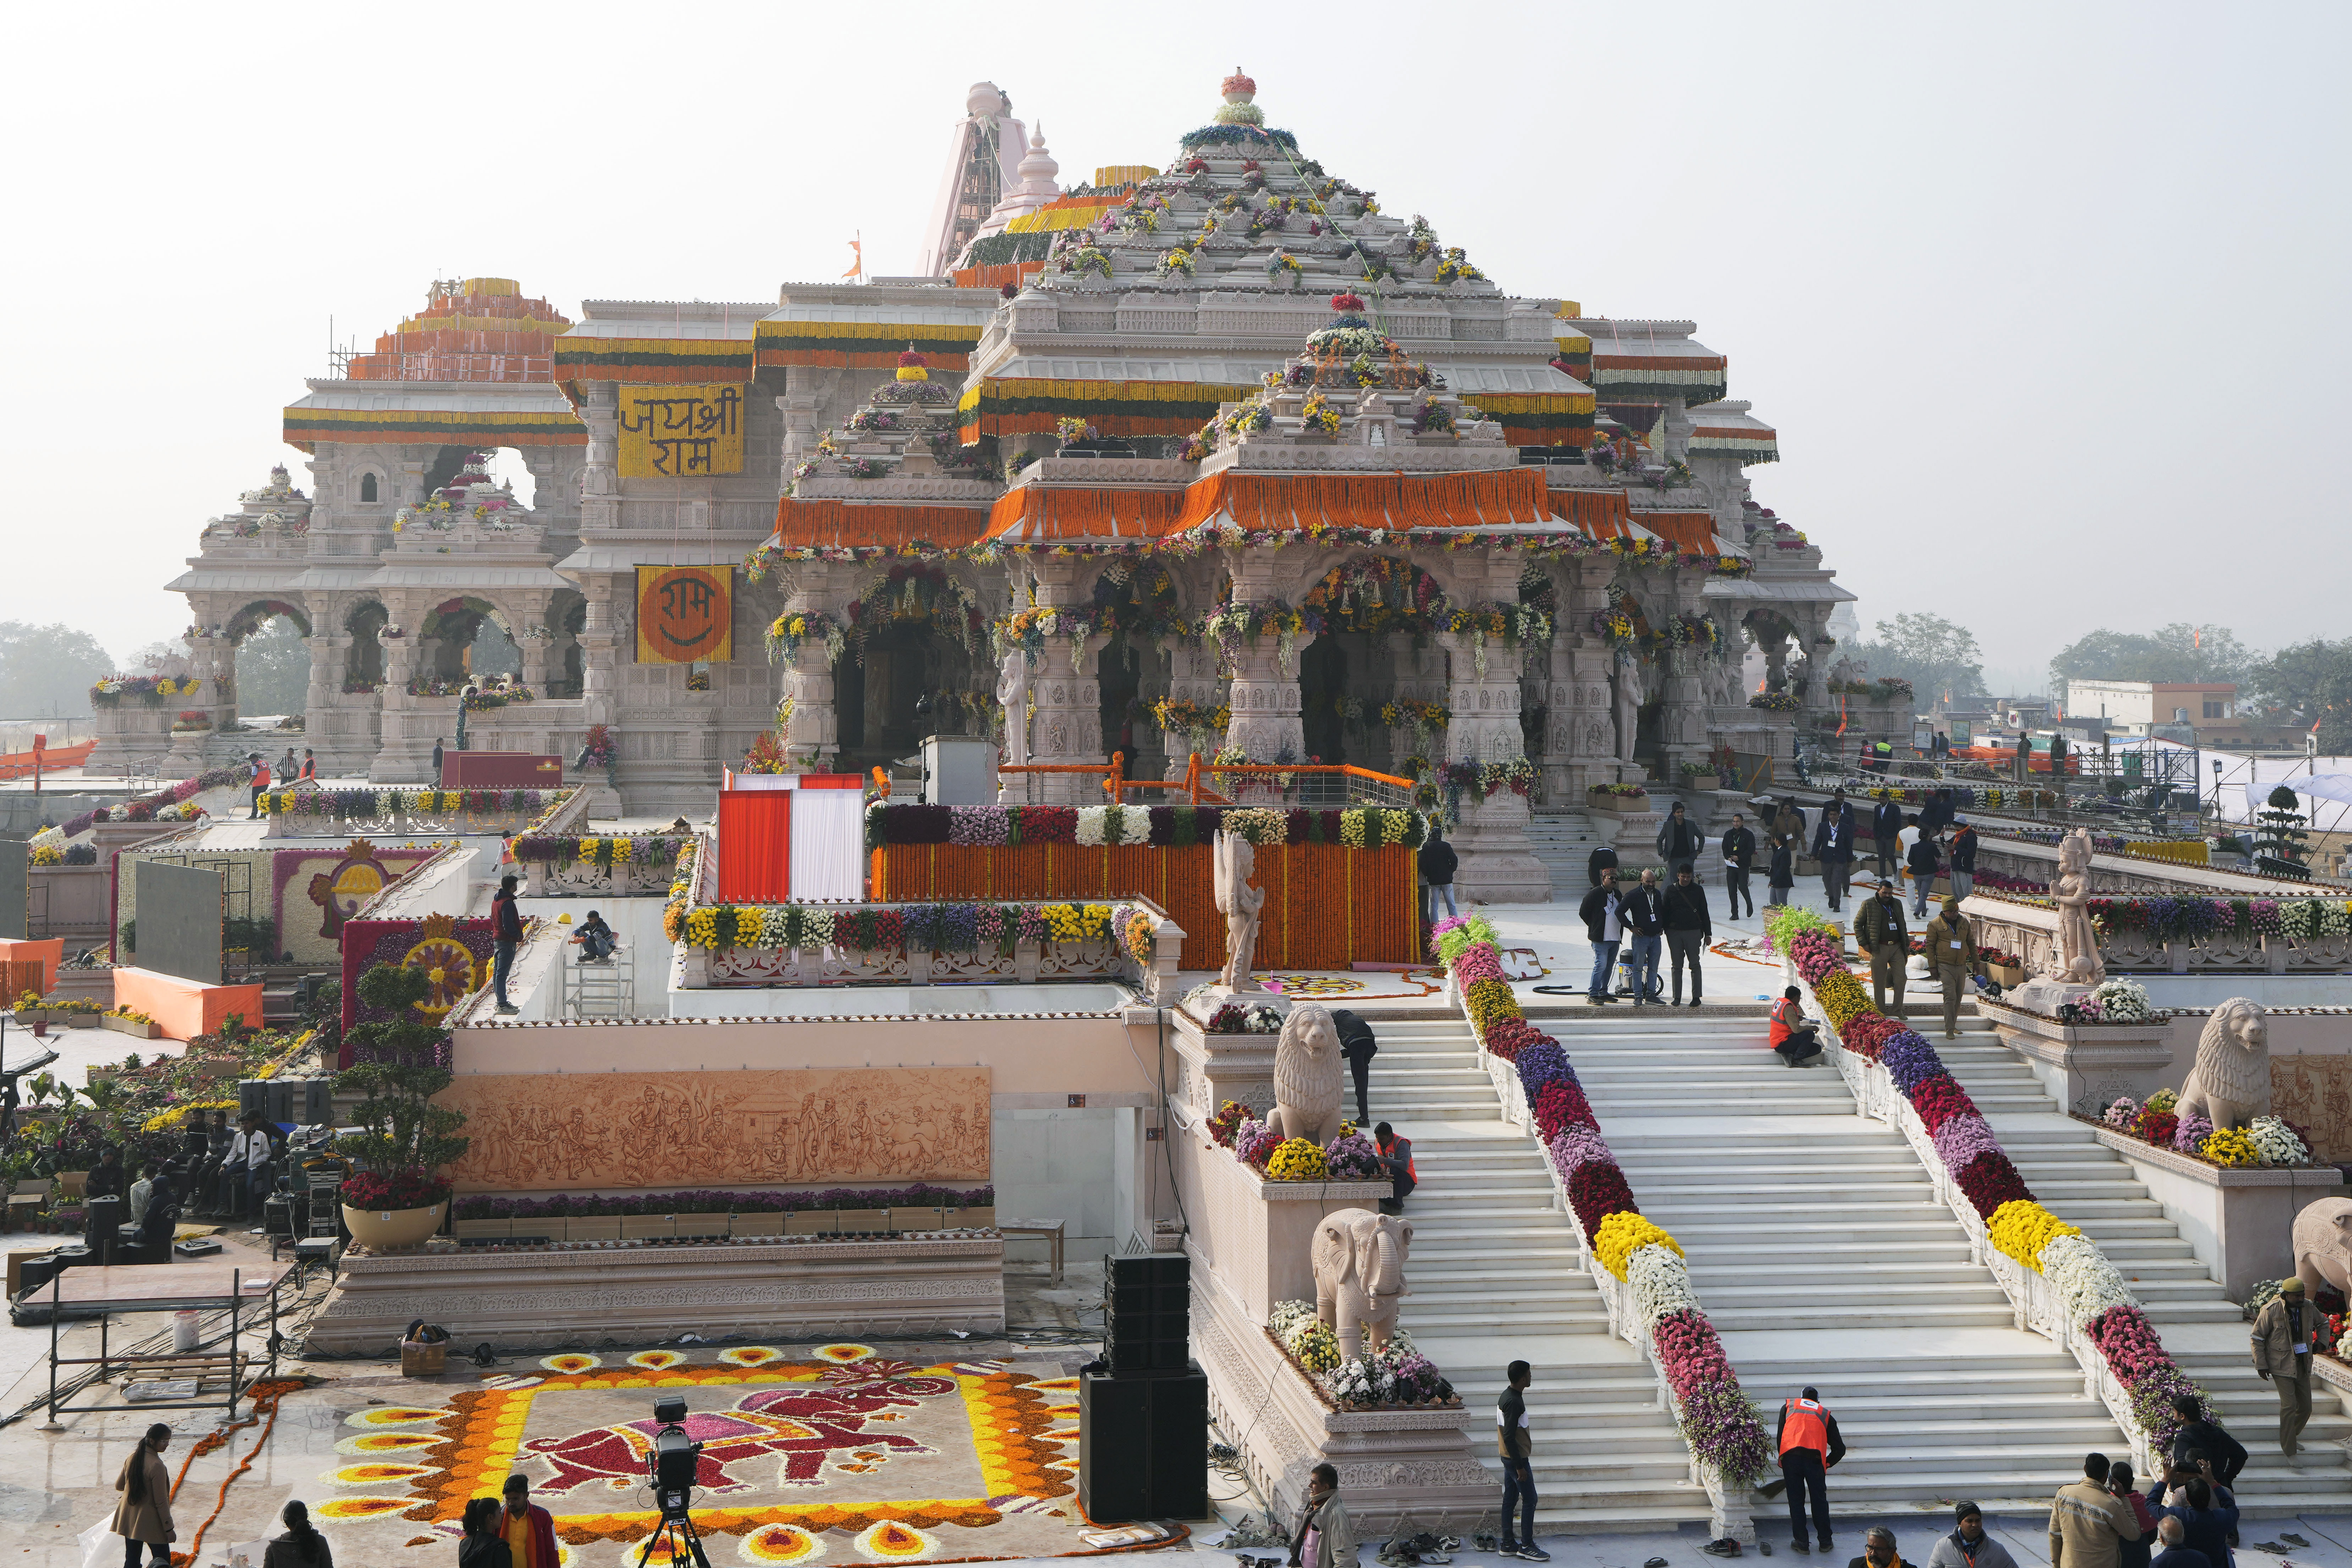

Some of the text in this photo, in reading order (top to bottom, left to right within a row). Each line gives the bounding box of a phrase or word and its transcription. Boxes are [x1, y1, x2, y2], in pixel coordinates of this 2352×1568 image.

[622, 387, 741, 437] जय श्री
[649, 437, 717, 475] राम
[659, 577, 715, 619] राम
